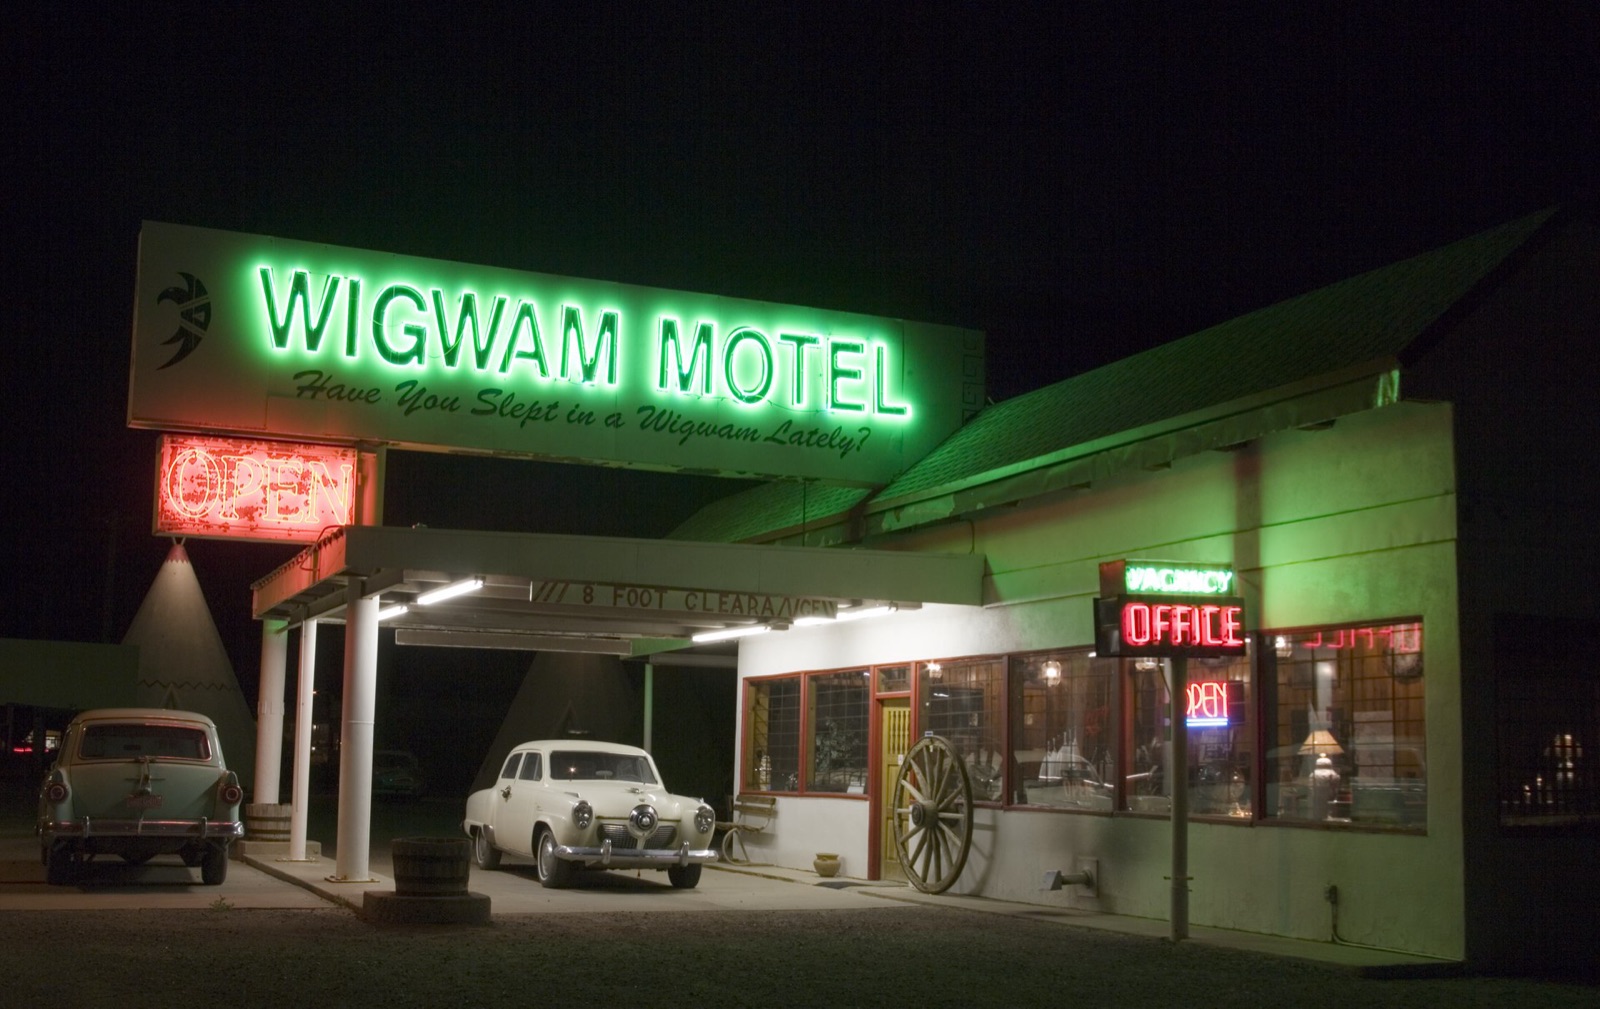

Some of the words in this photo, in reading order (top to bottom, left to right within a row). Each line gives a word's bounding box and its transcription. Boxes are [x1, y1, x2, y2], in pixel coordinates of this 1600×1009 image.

[257, 264, 622, 384] WIGWAM
[657, 314, 913, 419] MOTEL
[293, 369, 382, 404] Have
[394, 379, 461, 417] You
[470, 388, 558, 429] Slept
[566, 402, 597, 426] in
[603, 411, 625, 429] a
[636, 404, 760, 447] Wigwam
[763, 418, 872, 459] Lately?
[167, 448, 354, 525] OPEN
[582, 584, 594, 605] 8
[612, 587, 669, 610] FOOT
[1125, 566, 1233, 594] VACANCY
[1122, 603, 1244, 646] OFFICE
